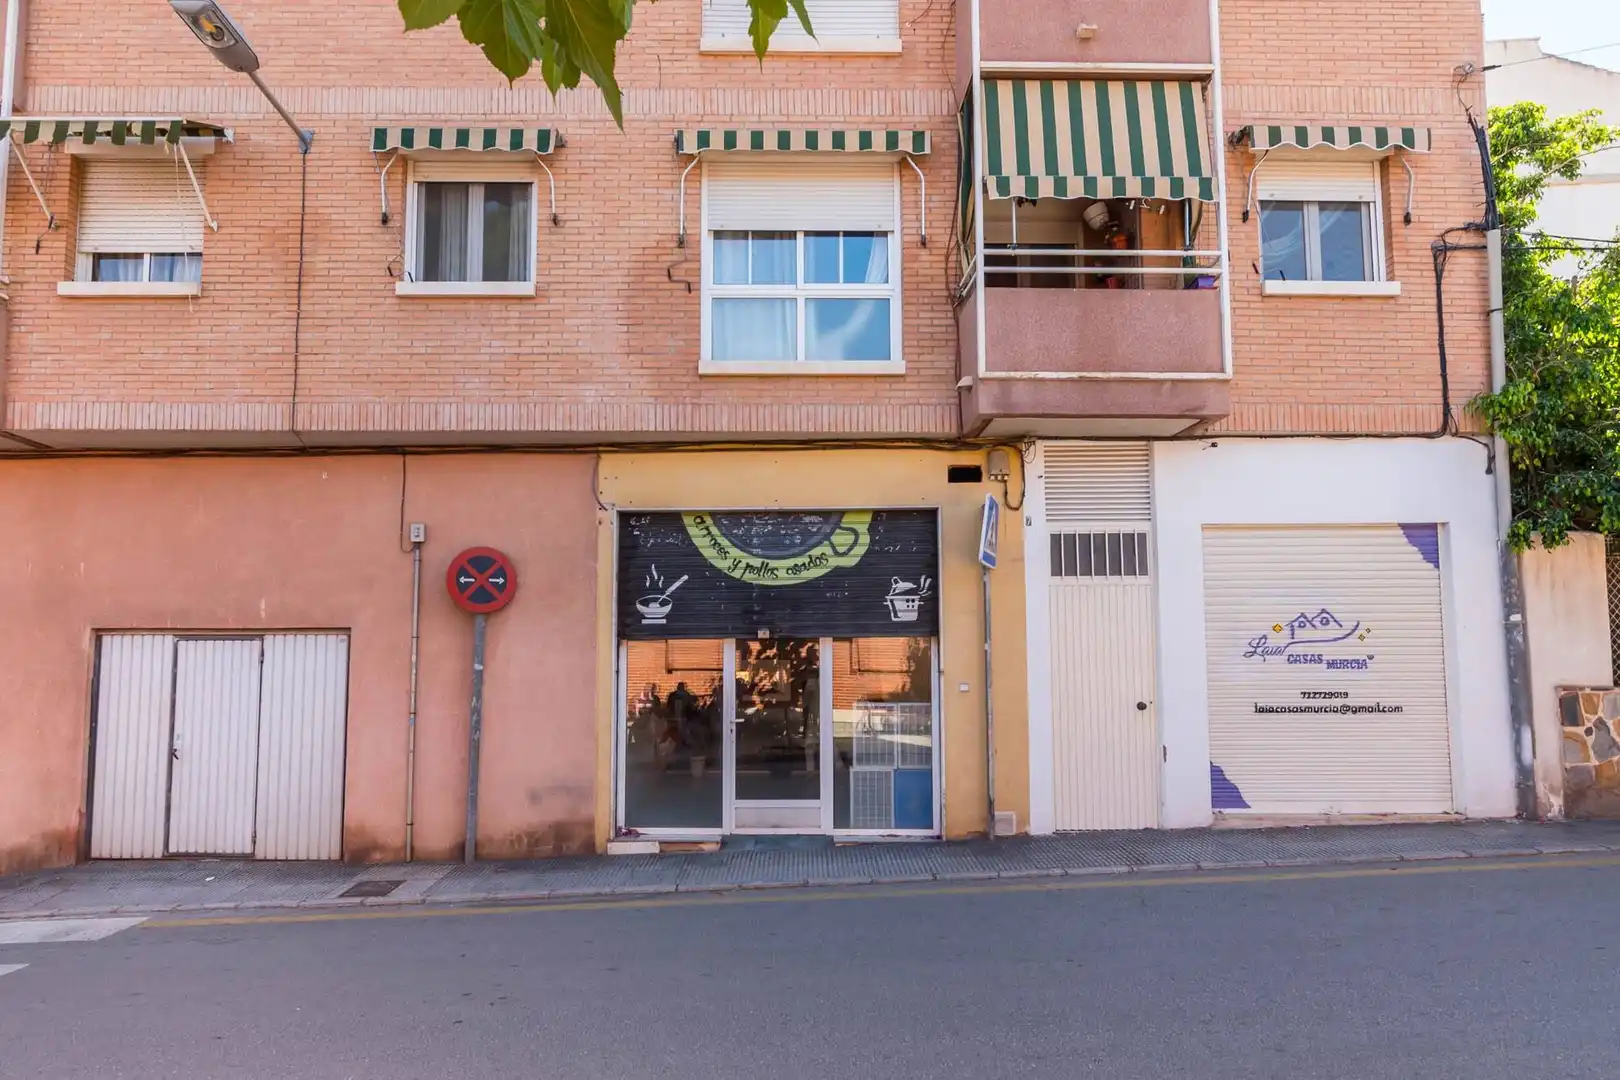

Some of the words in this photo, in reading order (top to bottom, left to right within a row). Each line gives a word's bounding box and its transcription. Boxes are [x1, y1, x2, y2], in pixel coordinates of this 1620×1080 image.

[693, 515, 731, 560] arroces
[728, 558, 742, 573] y
[740, 560, 779, 580] pollos
[786, 552, 829, 576] asados
[1287, 654, 1324, 664] CASAS
[1326, 659, 1368, 669] MURCIA
[1301, 691, 1349, 699] 722729019
[1254, 702, 1403, 714] laiacasasmurcia@gmail.com
